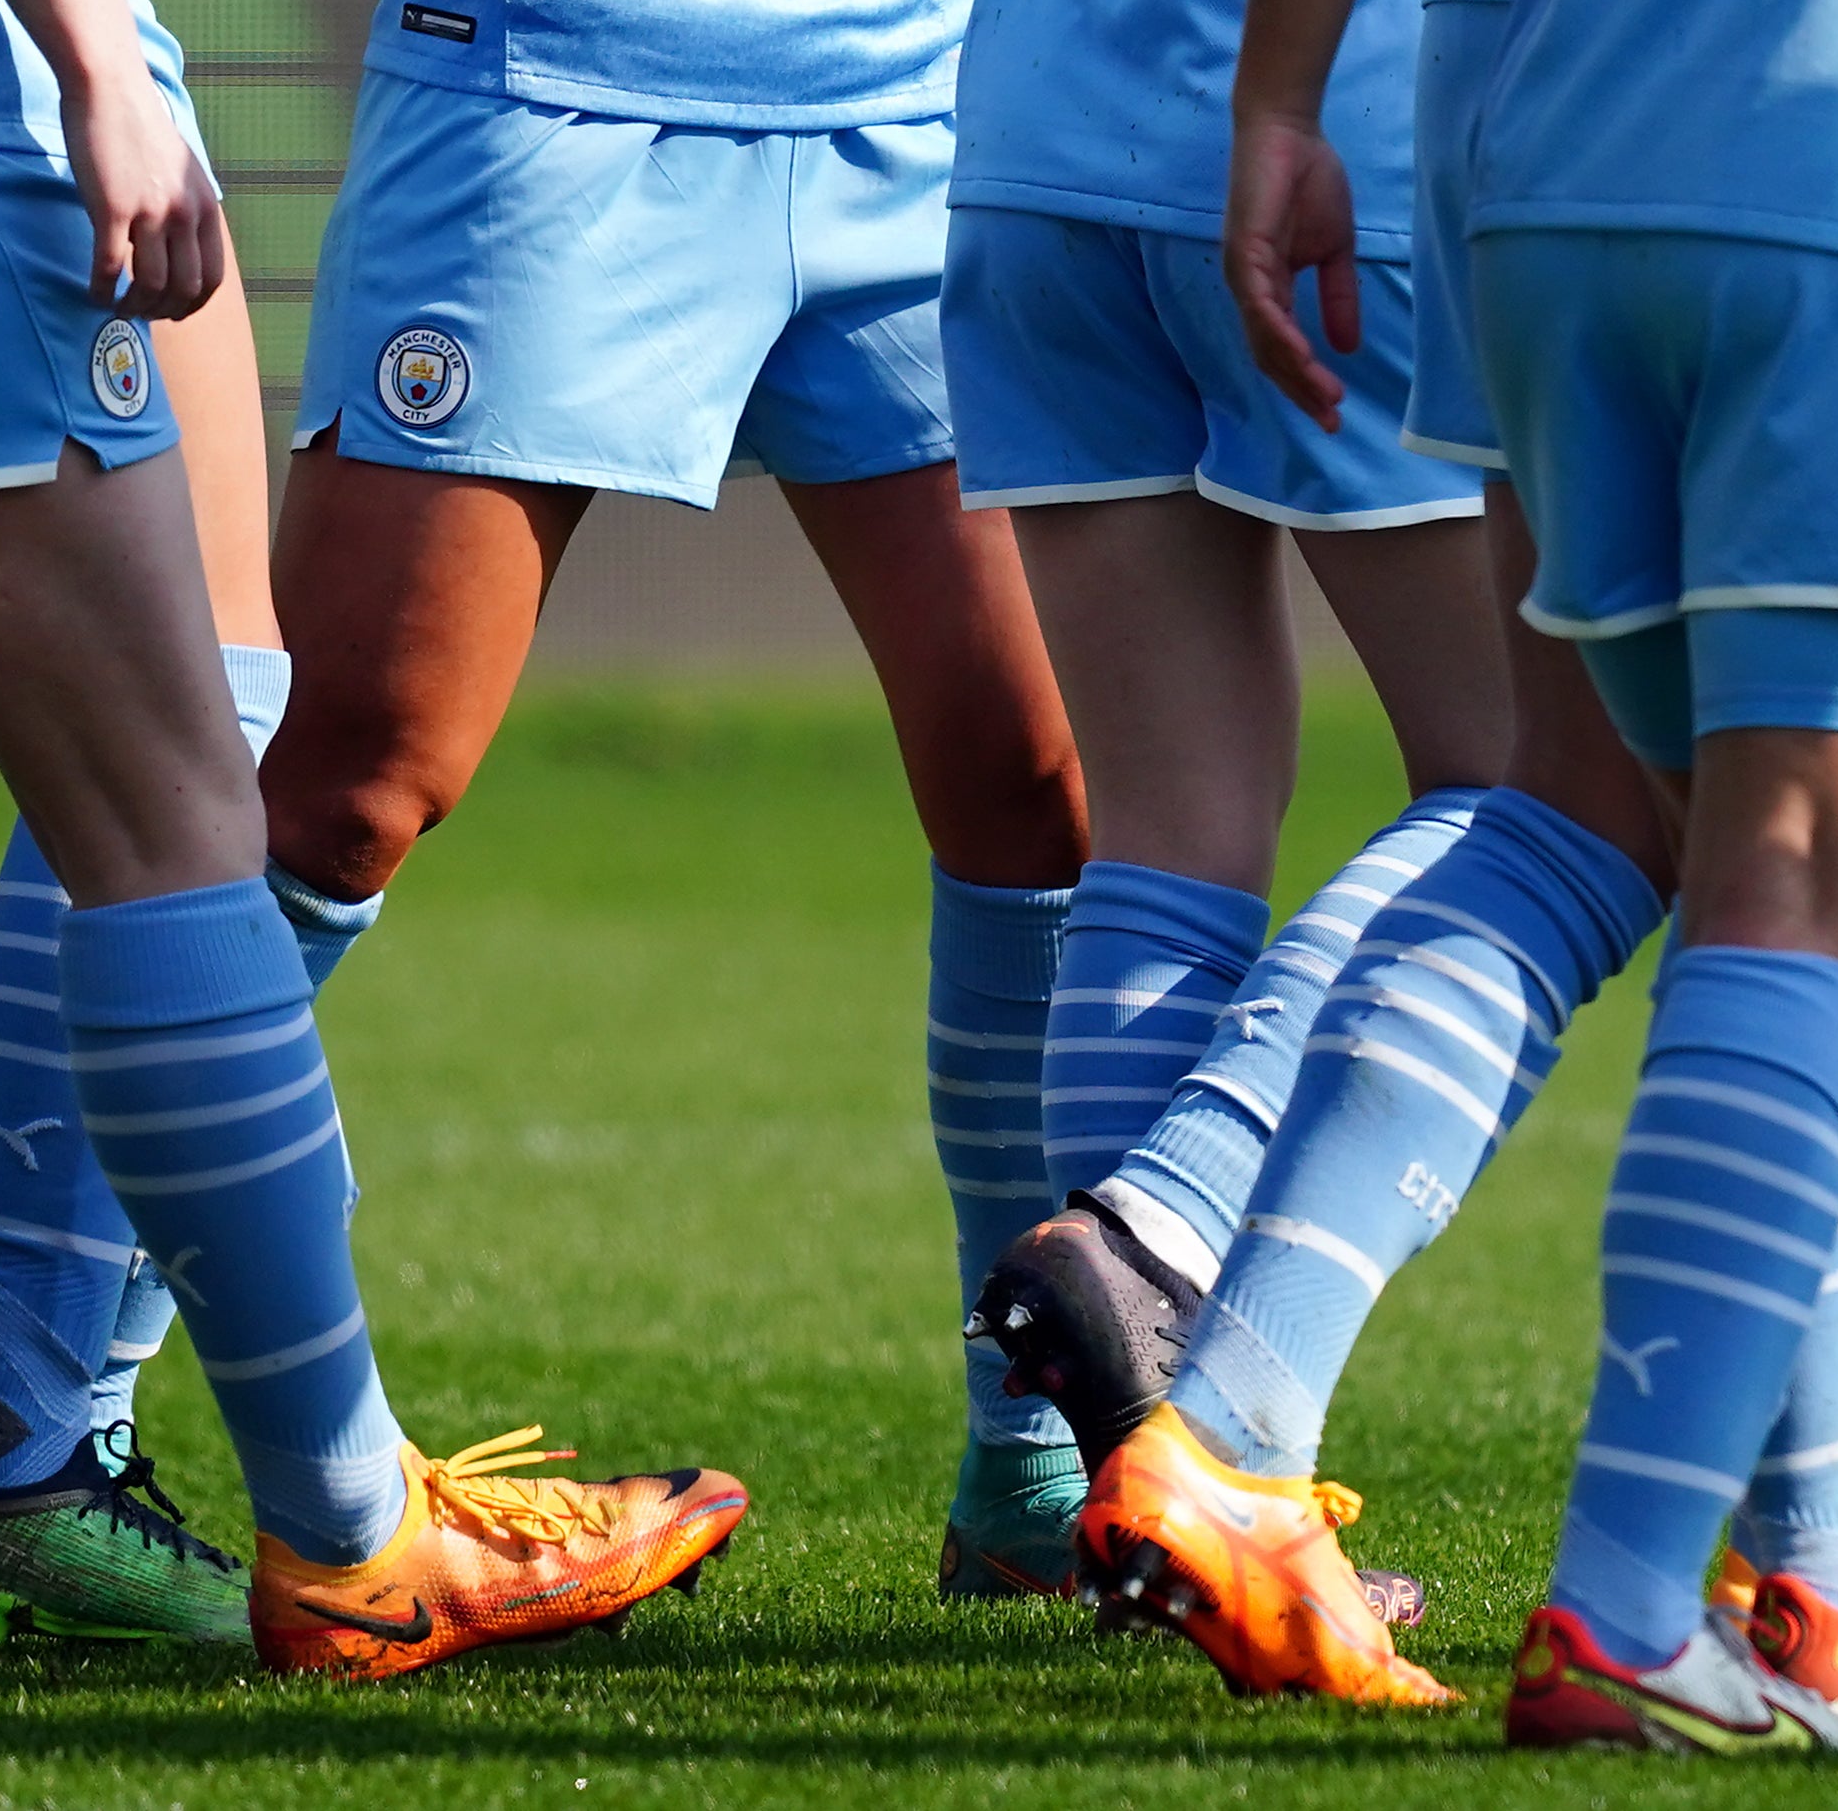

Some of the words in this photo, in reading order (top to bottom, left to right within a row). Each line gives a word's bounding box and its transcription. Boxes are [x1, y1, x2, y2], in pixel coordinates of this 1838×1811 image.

[387, 333, 462, 370] MANCHESTER
[402, 409, 430, 422] CITY
[1396, 1161, 1460, 1232] CIT
